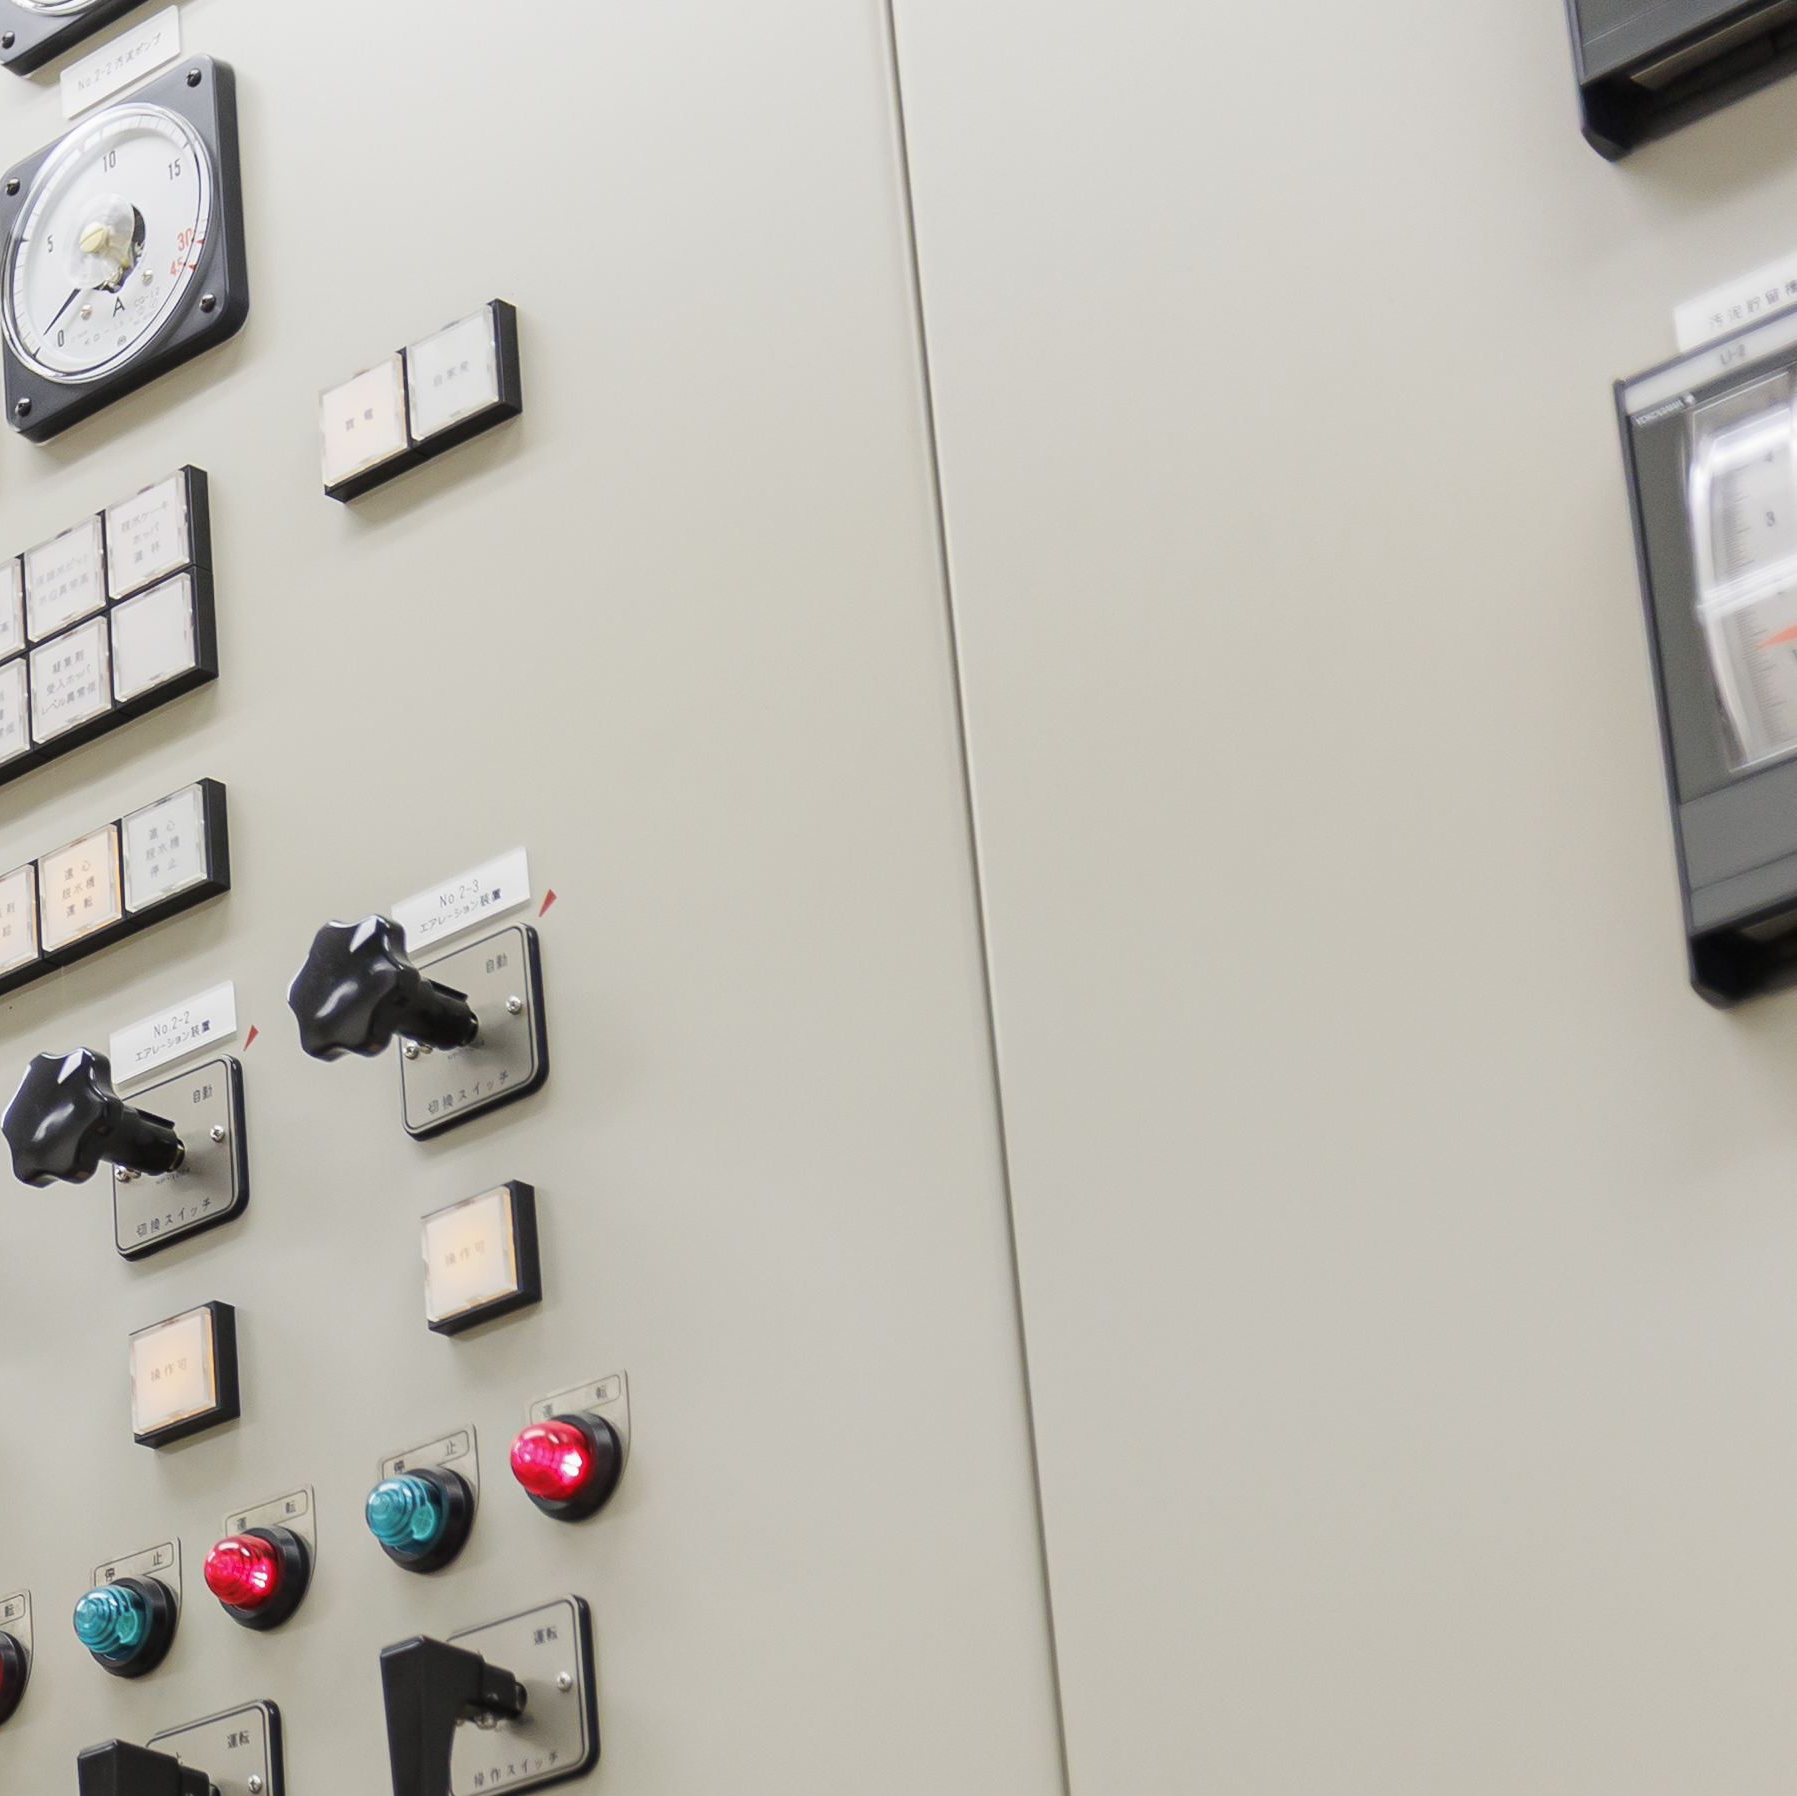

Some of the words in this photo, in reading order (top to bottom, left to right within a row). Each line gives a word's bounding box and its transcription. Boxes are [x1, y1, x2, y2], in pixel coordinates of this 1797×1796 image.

[102, 151, 116, 173] 10
[168, 162, 182, 180] 15
[178, 228, 191, 251] 30
[112, 295, 126, 317] A
[439, 878, 480, 909] No.2-3
[485, 952, 508, 975] 自動
[153, 1010, 191, 1039] No.2-2
[192, 1083, 213, 1105] 自動
[426, 1069, 509, 1116] 切換スイッチ
[136, 1197, 212, 1238] 切換スイッチ
[533, 1626, 558, 1646] 運転
[227, 1730, 250, 1750] 運転
[474, 1751, 560, 1789] 操作スイッチ
